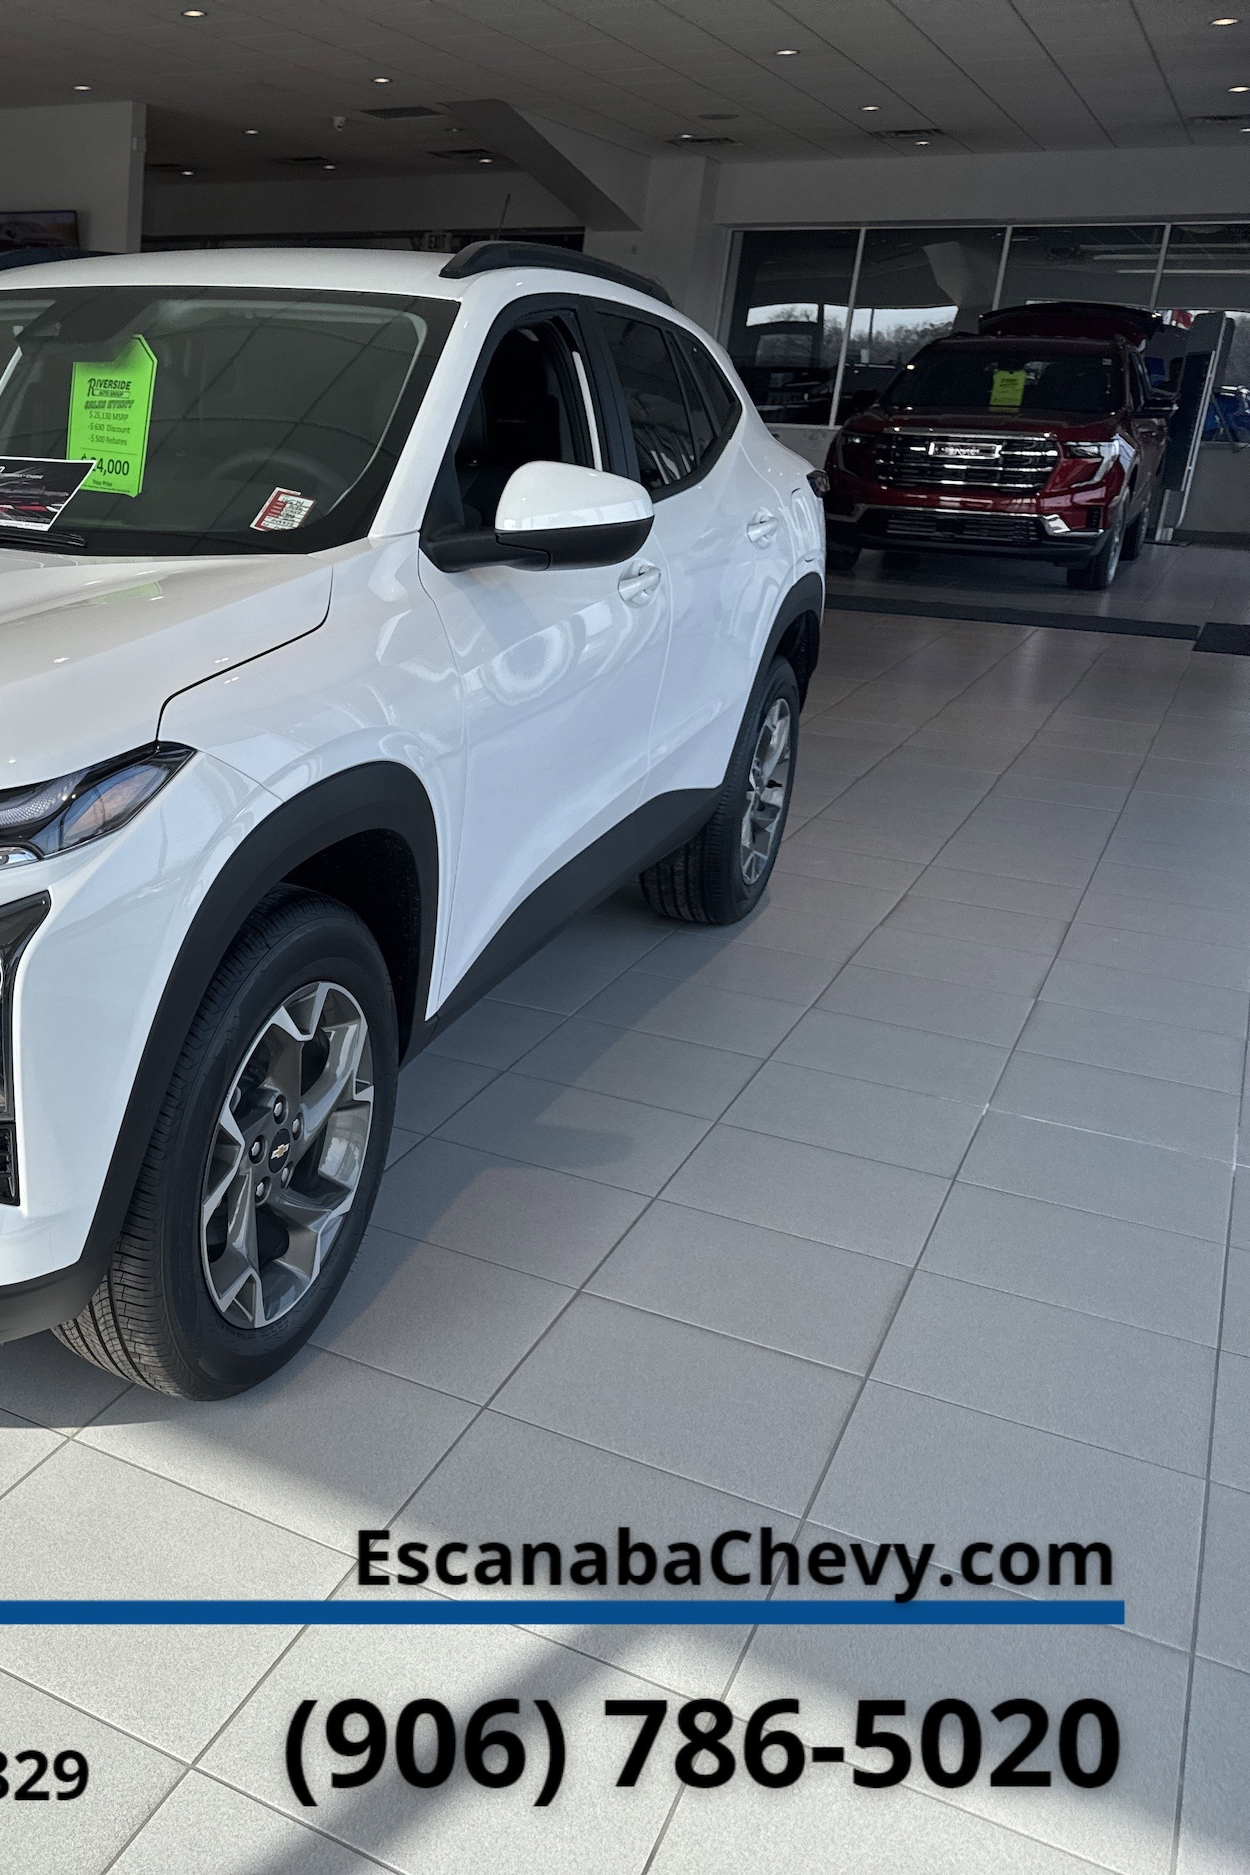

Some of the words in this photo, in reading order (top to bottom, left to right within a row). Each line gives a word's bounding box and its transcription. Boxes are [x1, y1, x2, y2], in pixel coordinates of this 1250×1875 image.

[87, 378, 132, 397] RIVERSIDE
[112, 413, 129, 421] MSRP
[106, 424, 130, 434] Discount
[106, 437, 127, 446] Rebates
